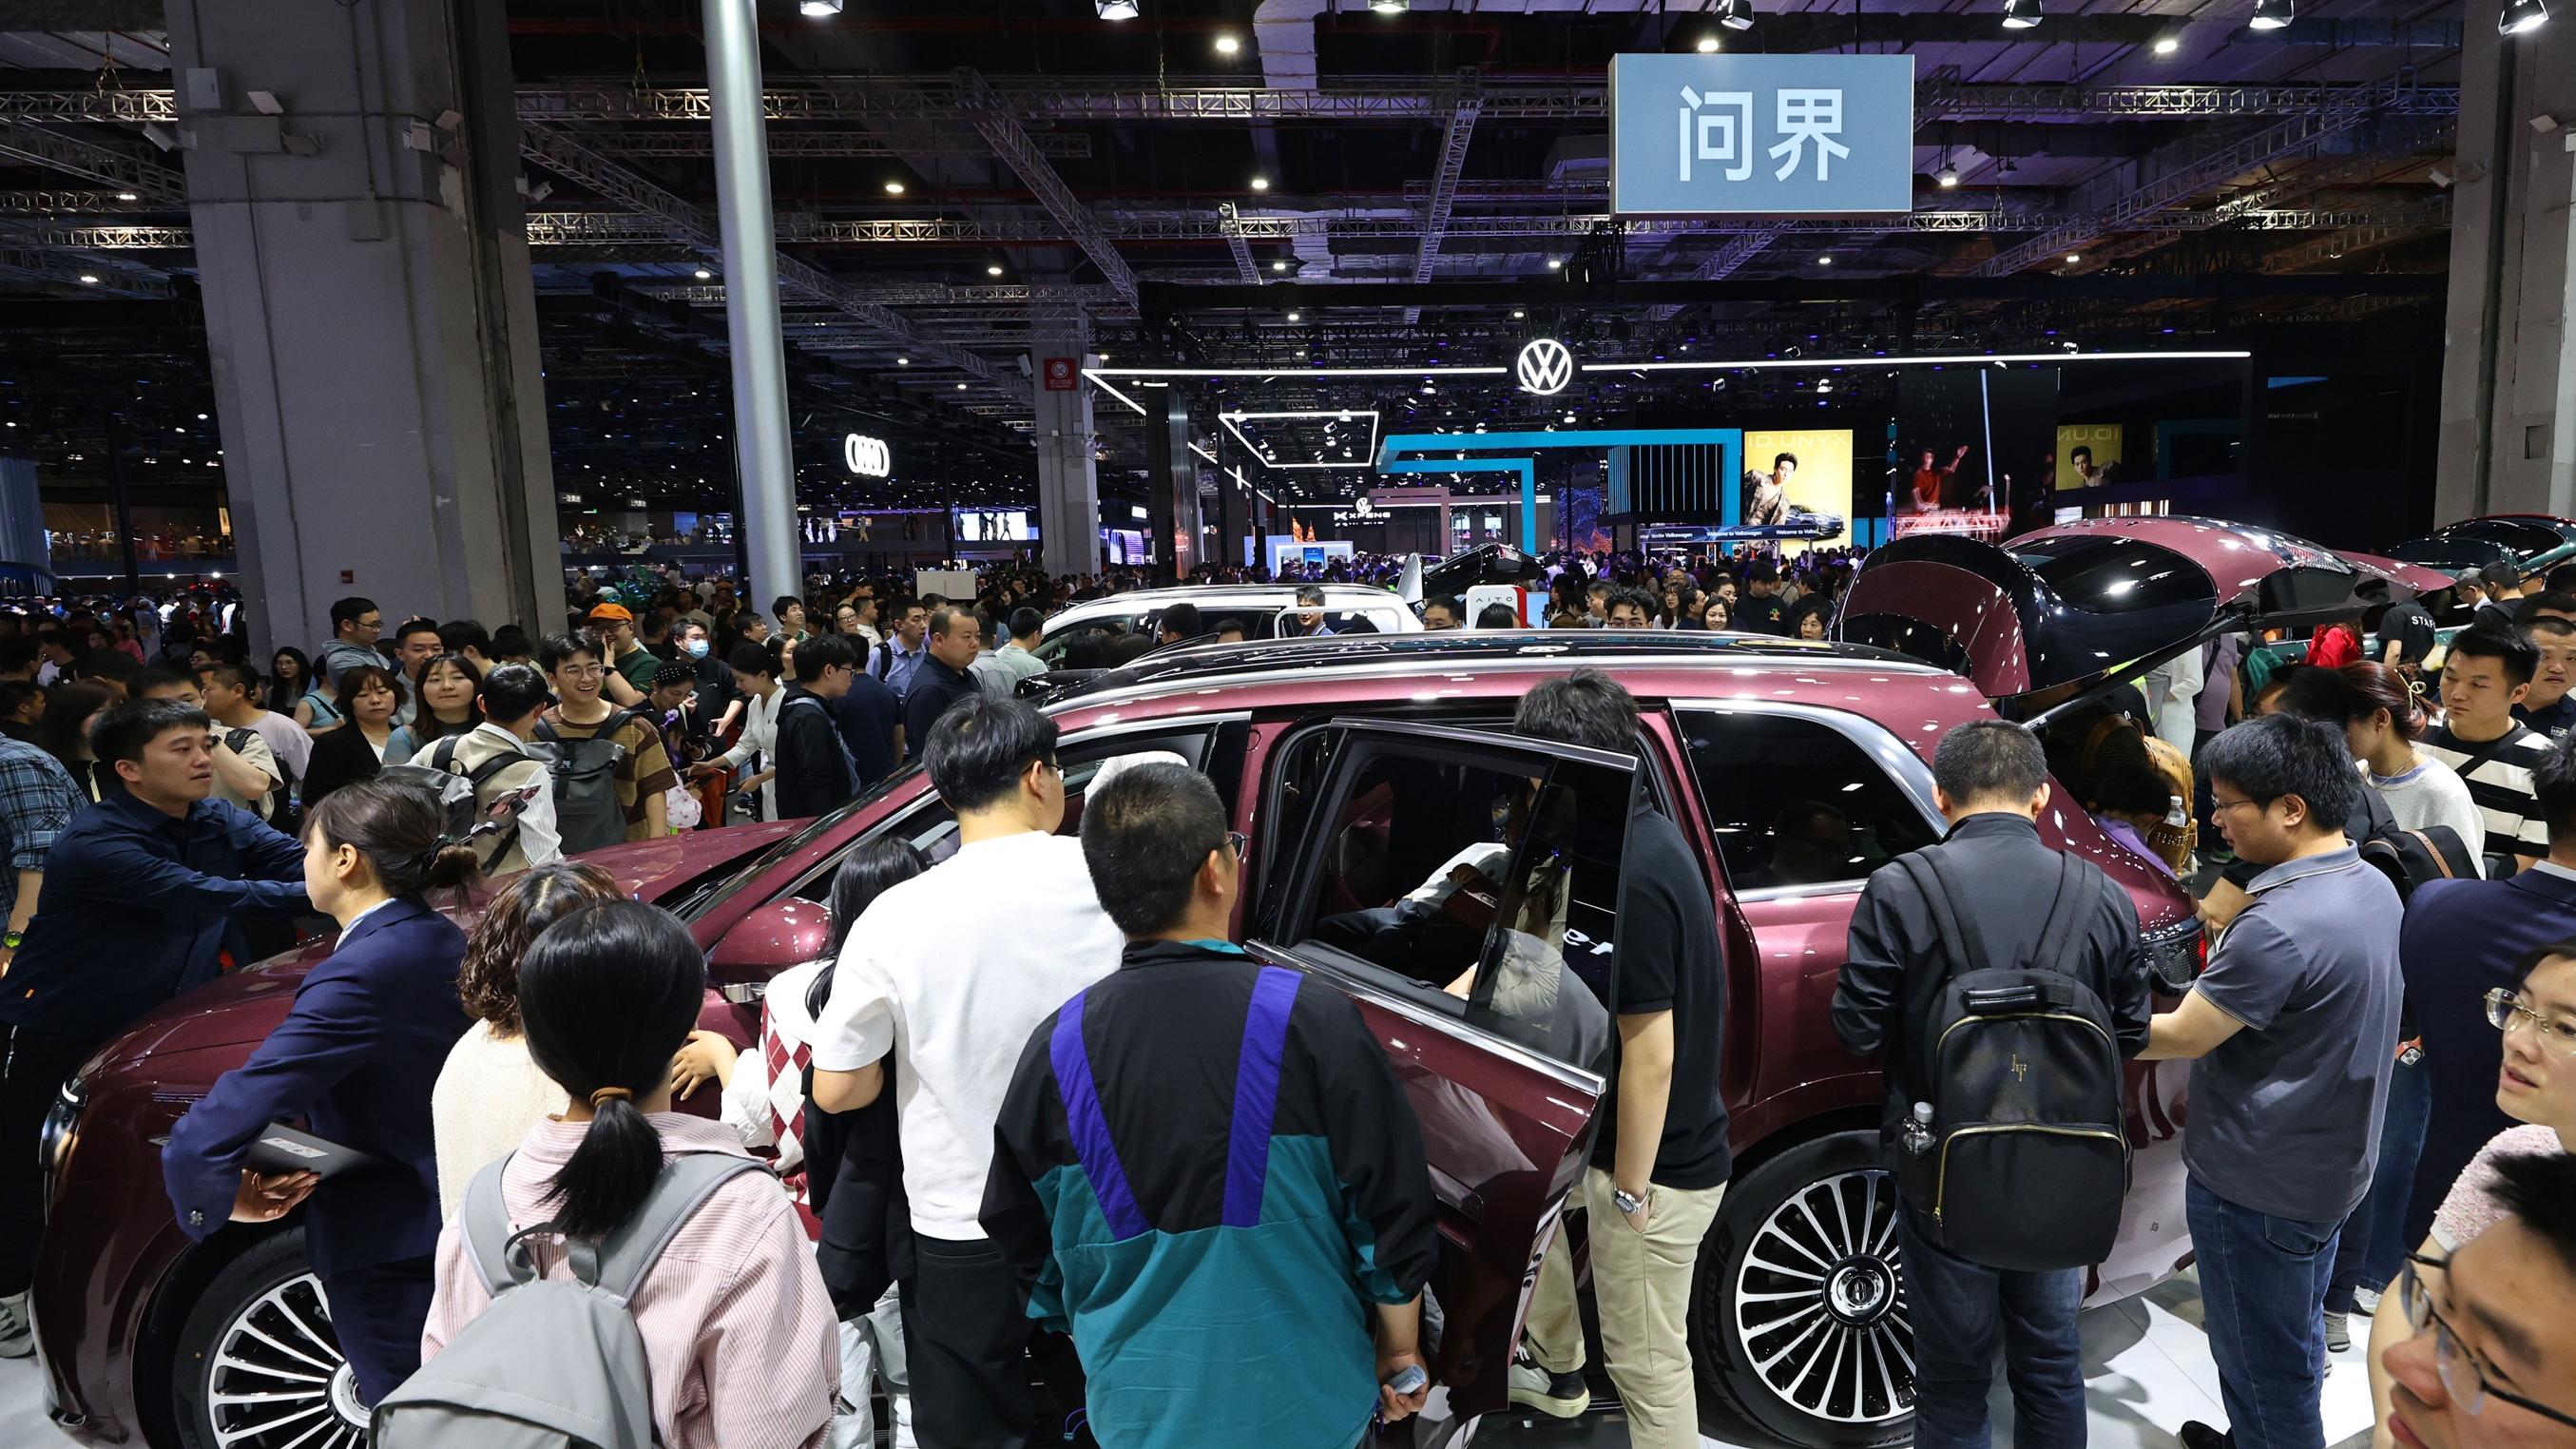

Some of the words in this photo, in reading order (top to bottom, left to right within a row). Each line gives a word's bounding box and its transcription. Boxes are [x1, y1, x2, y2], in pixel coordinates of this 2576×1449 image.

[1680, 85, 1850, 183] 问界
[1779, 434, 1849, 447] UNYX
[2411, 615, 2435, 628] STAF
